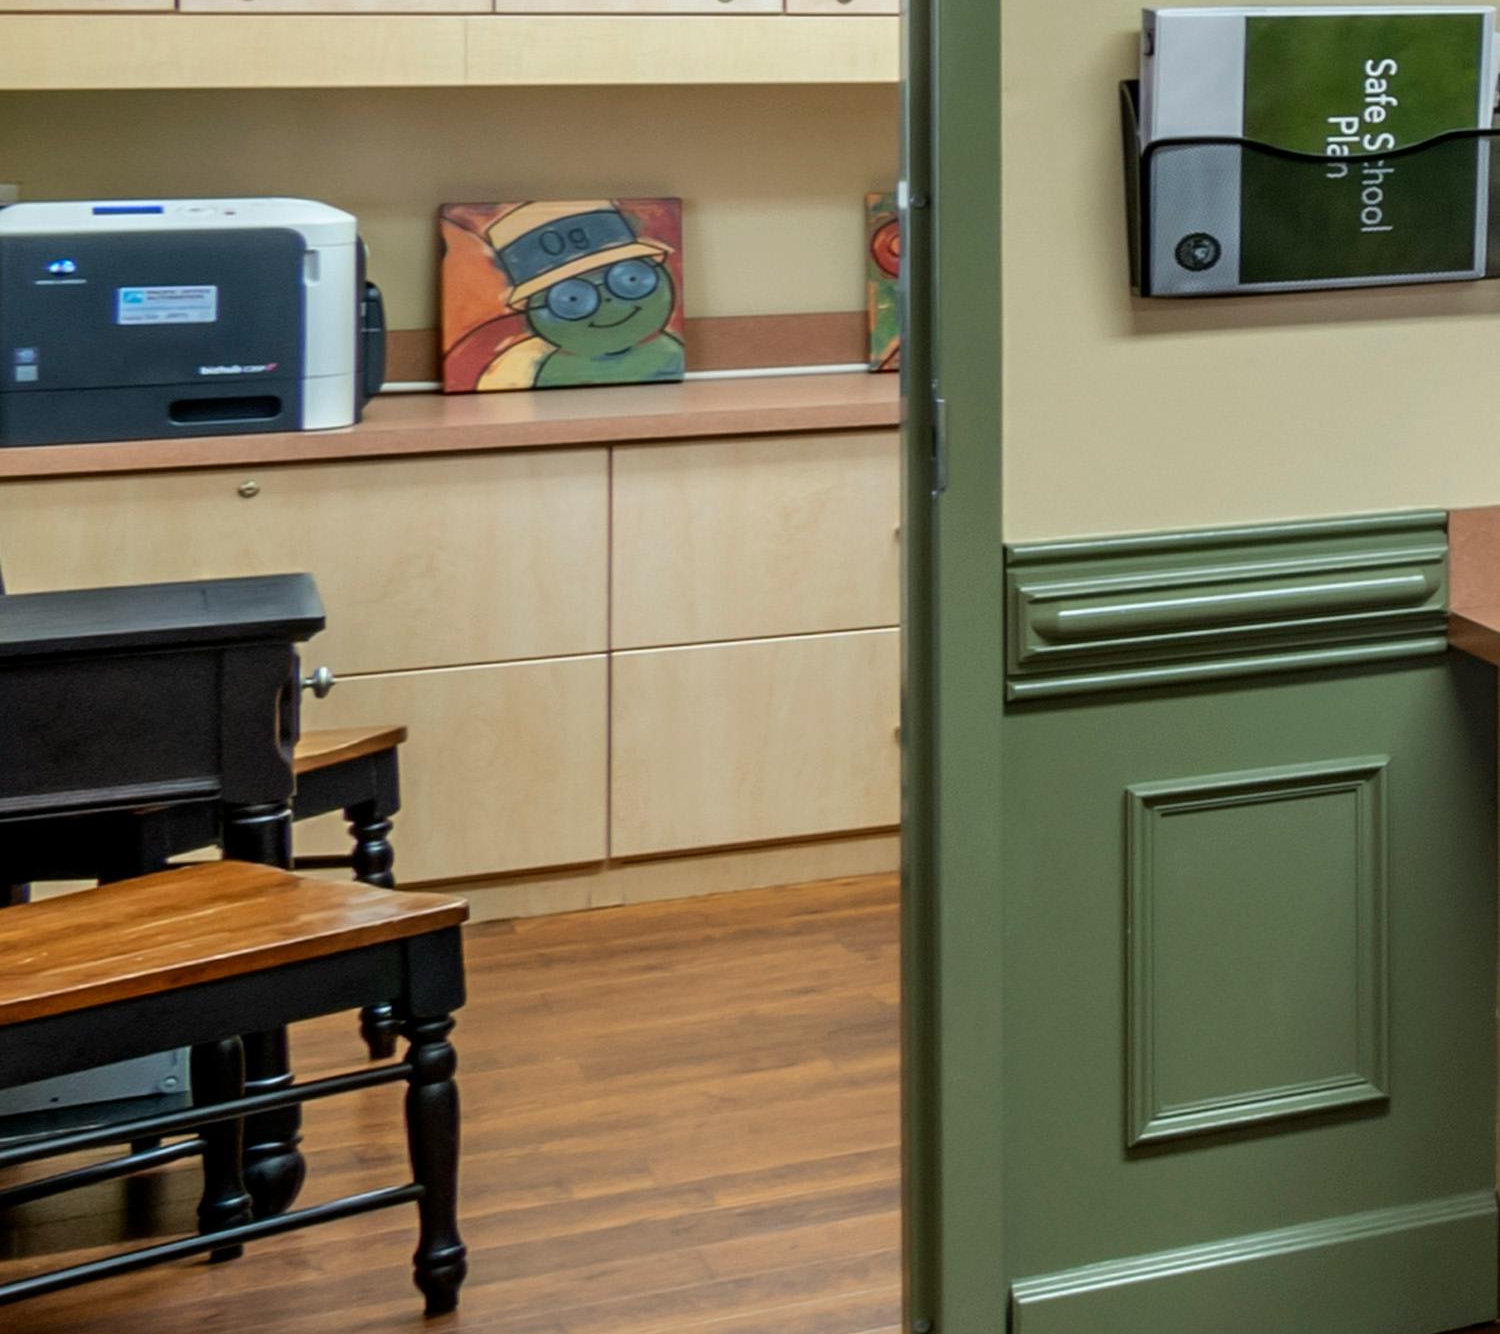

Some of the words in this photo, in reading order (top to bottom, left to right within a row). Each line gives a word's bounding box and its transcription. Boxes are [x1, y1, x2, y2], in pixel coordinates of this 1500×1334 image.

[1364, 58, 1398, 123] Safe
[1326, 117, 1360, 179] Plan
[1360, 132, 1396, 232] Shool
